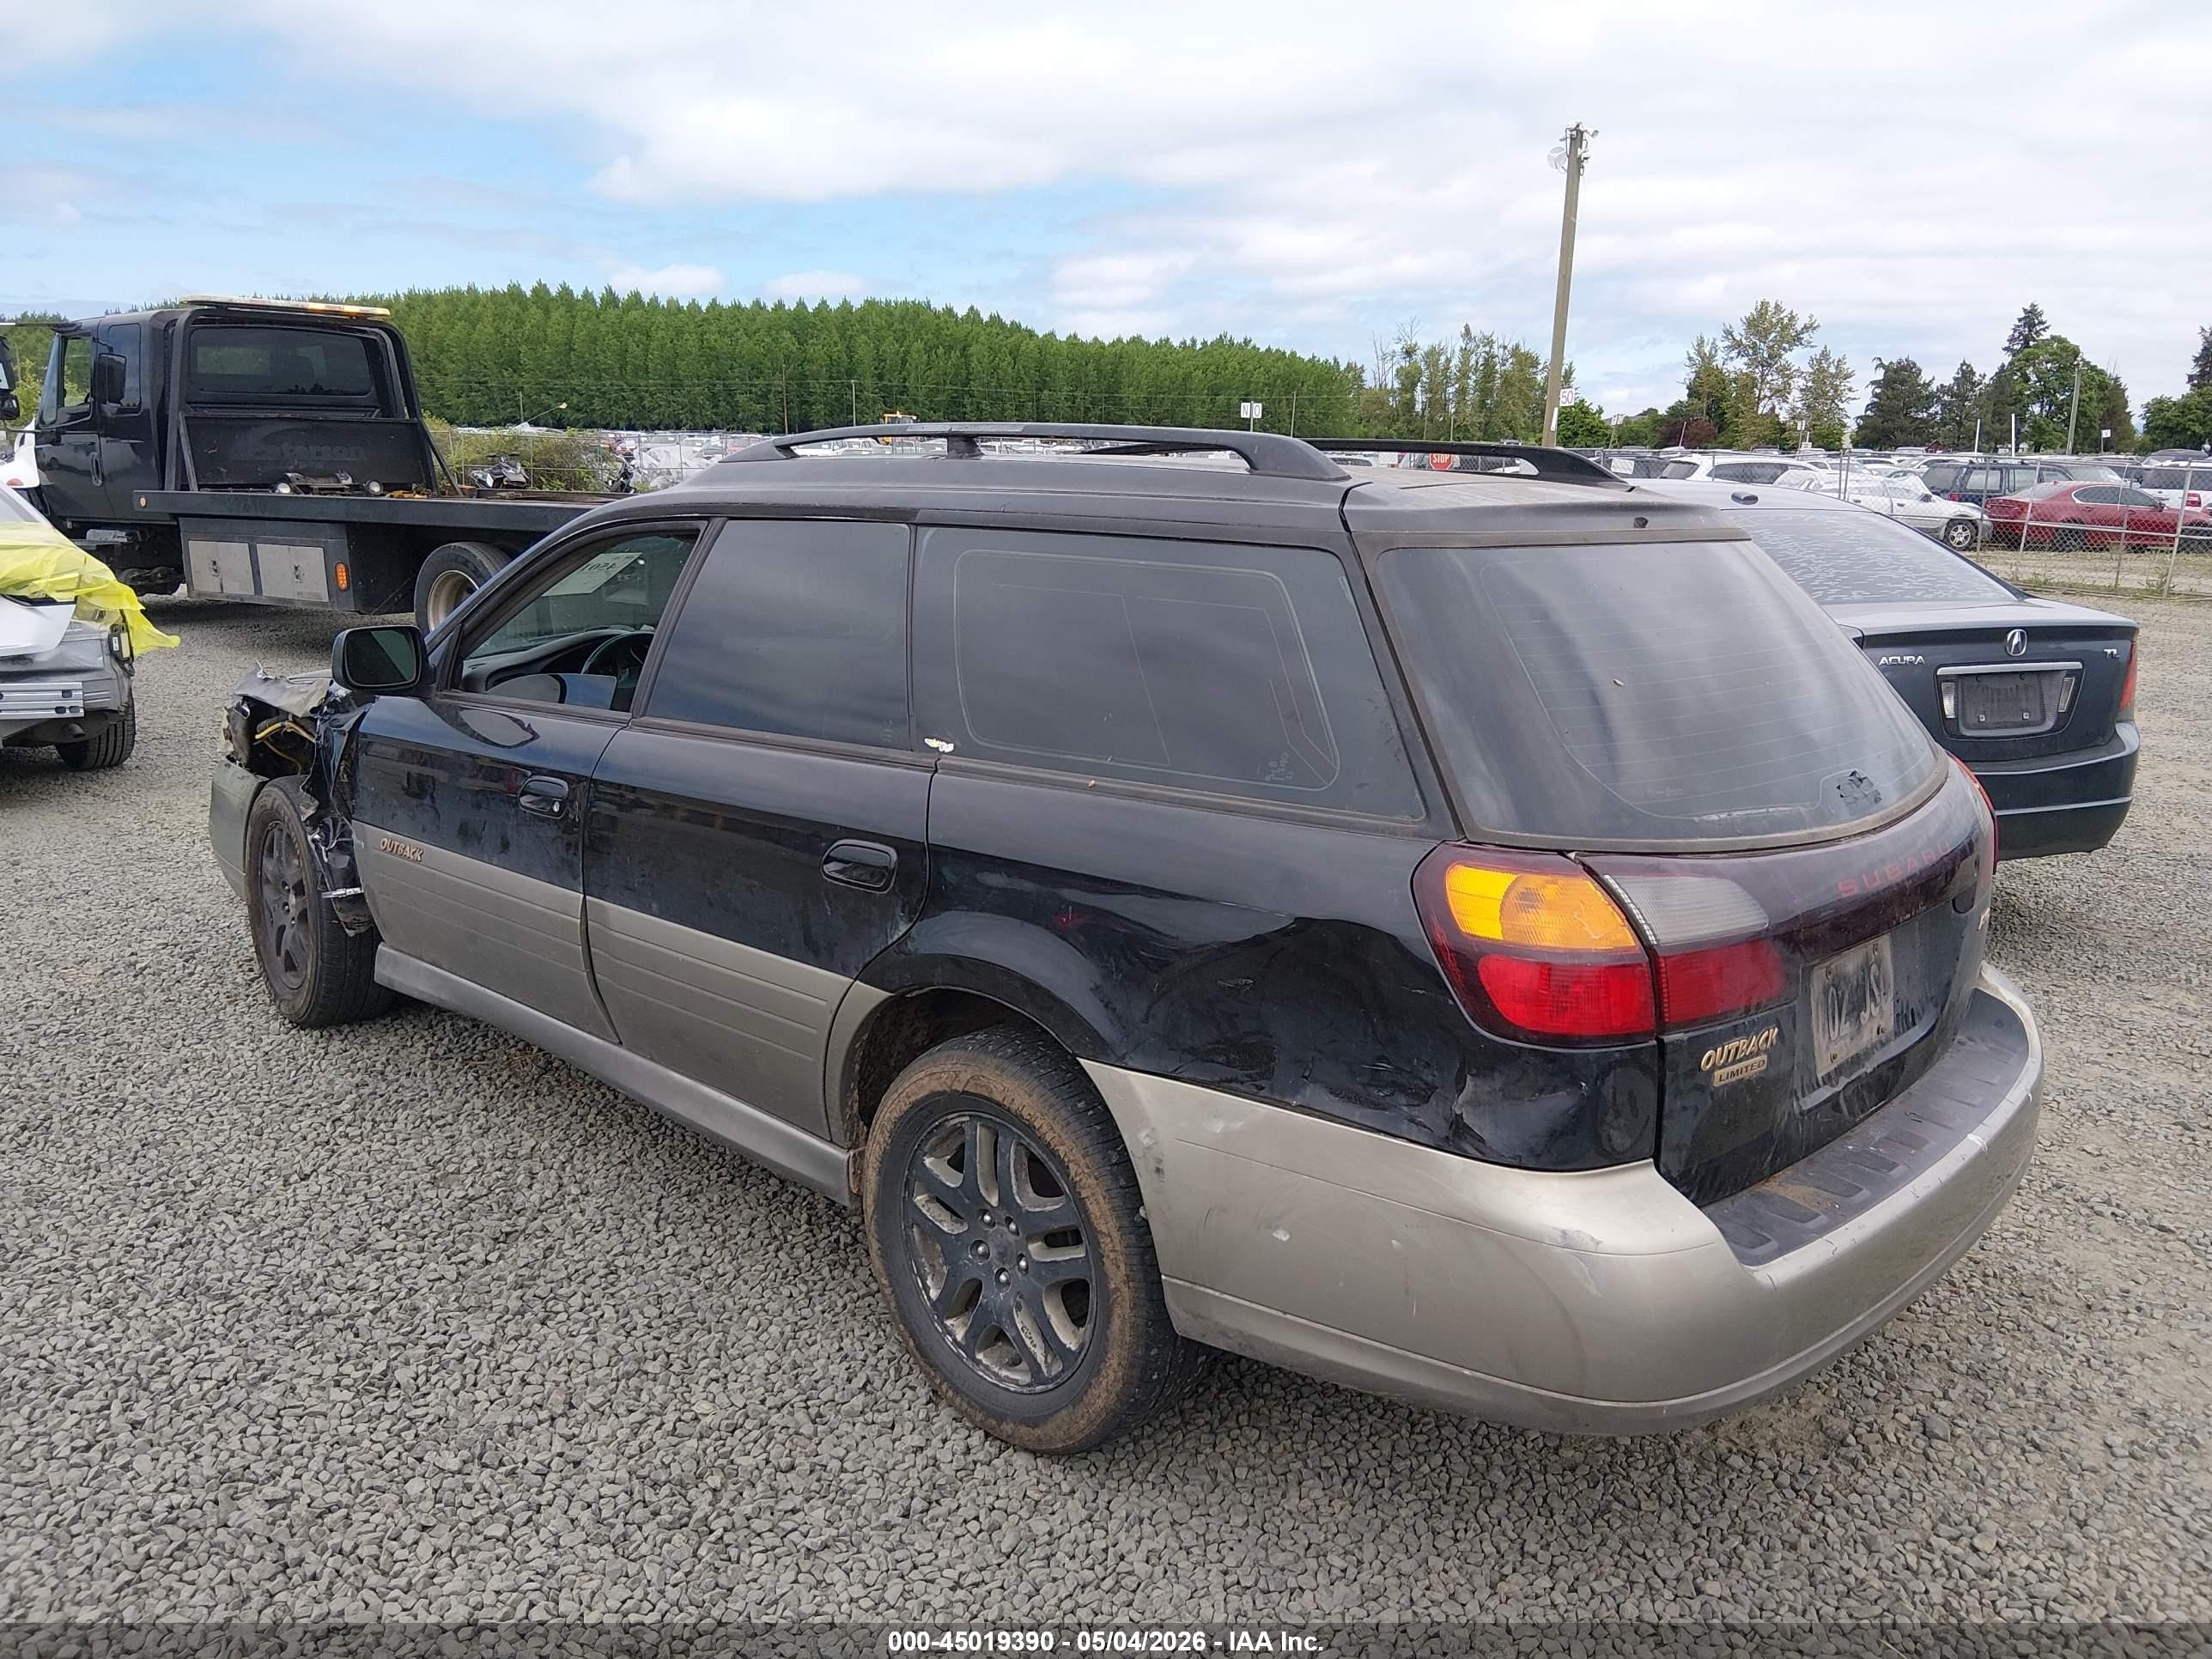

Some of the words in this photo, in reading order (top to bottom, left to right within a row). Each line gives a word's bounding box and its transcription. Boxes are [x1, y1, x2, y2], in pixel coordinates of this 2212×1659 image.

[1561, 390, 1574, 404] 50
[1432, 453, 1449, 464] STOP
[1879, 655, 1925, 665] ACURA
[2103, 648, 2122, 659] TL
[380, 837, 425, 862] OUTBACK
[1837, 841, 1953, 898] SUBARU
[1700, 1026, 1779, 1072] OUTBACK
[1718, 1059, 1766, 1083] LIMITED
